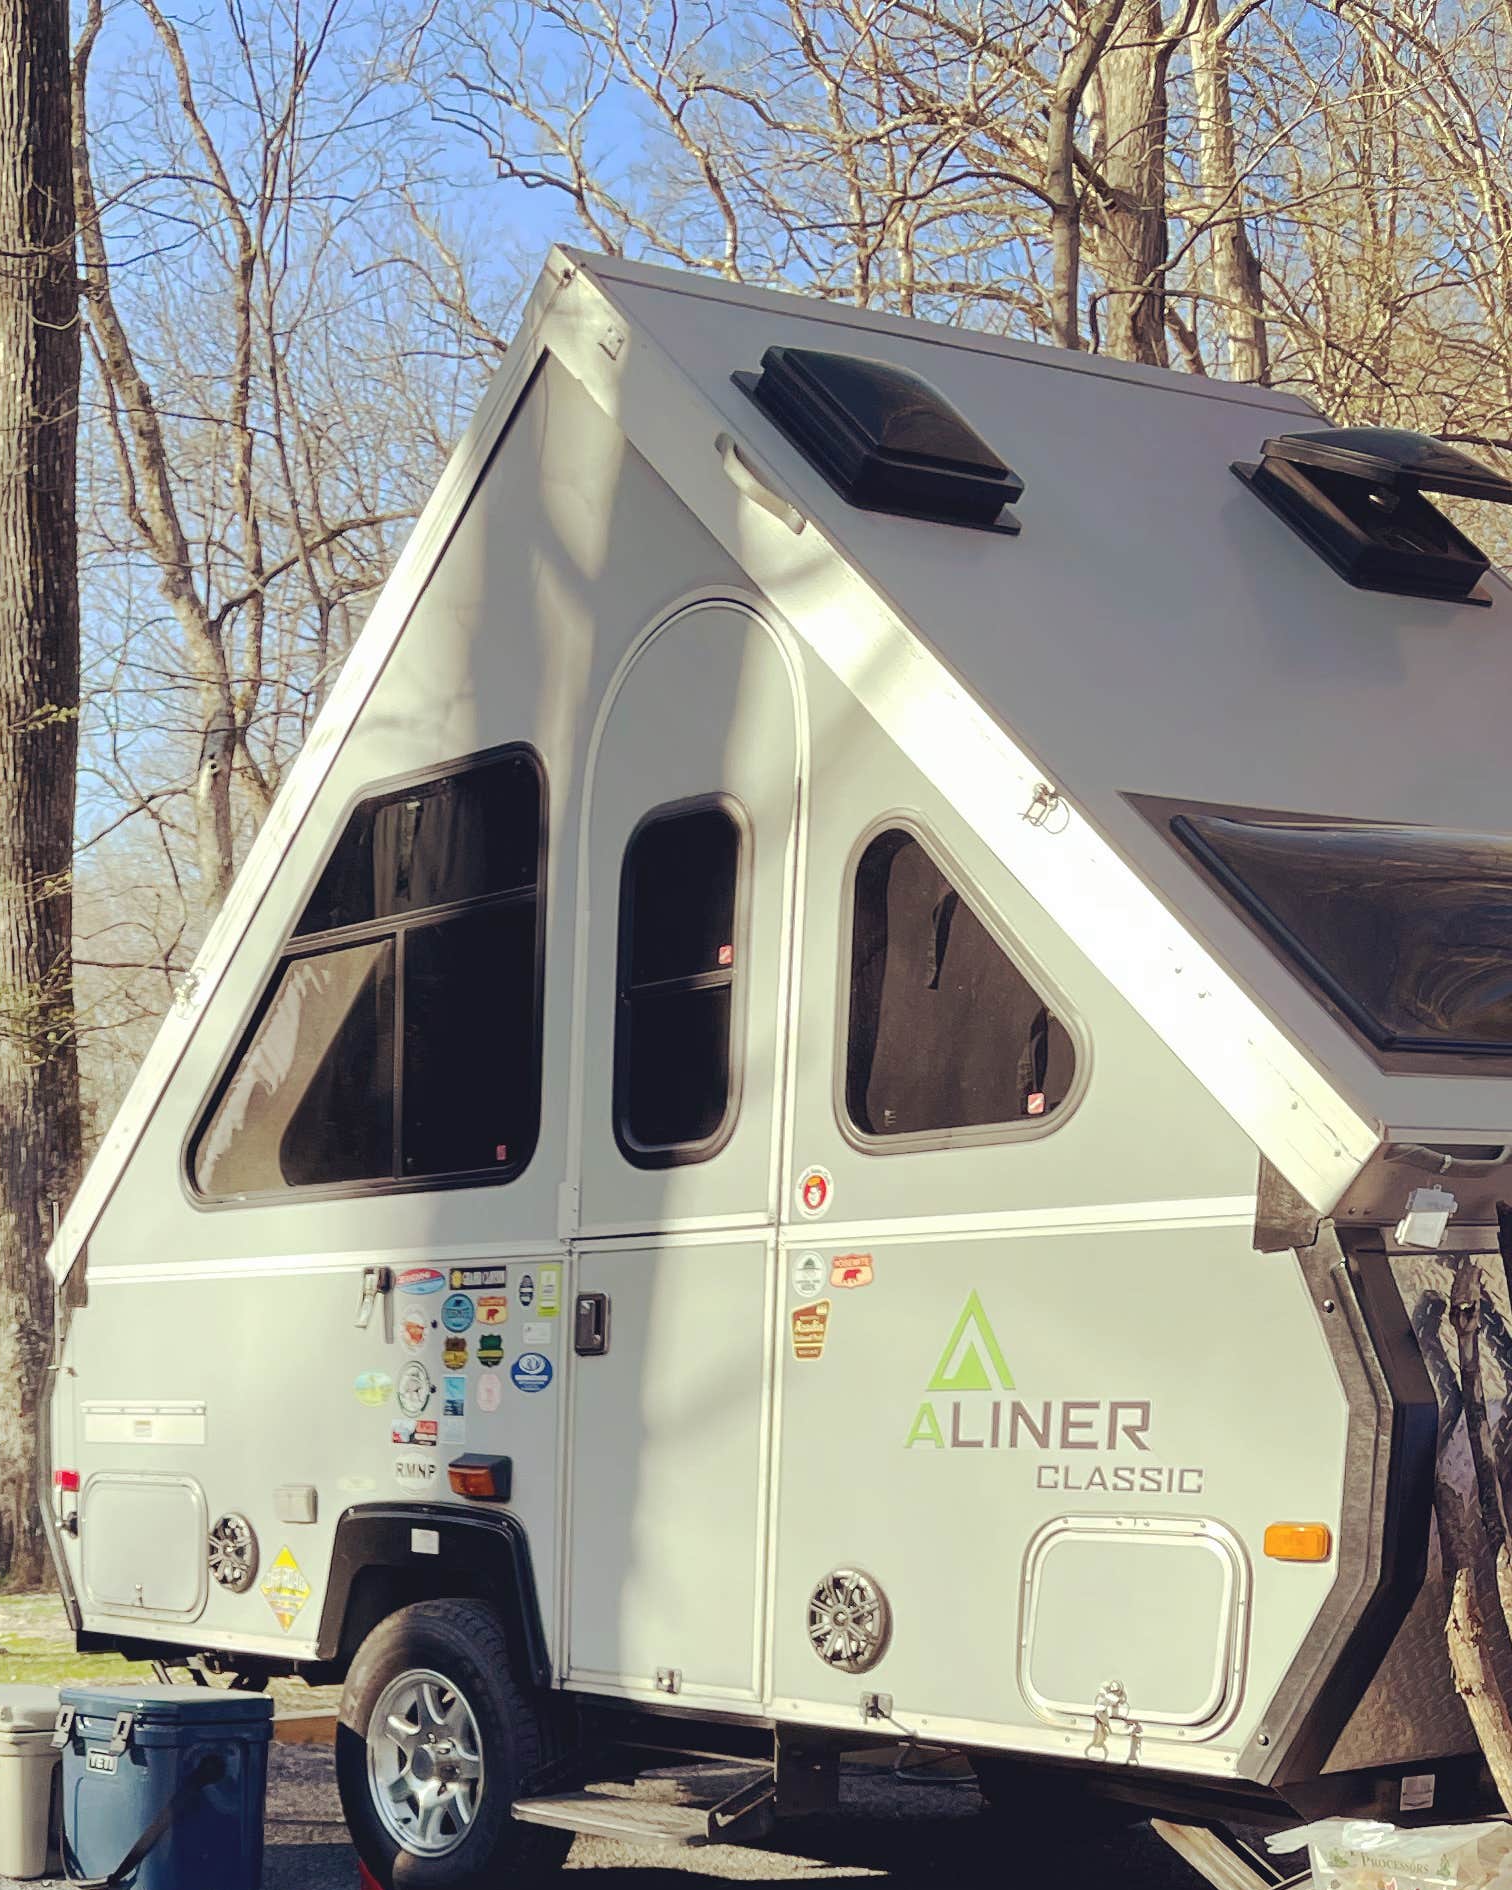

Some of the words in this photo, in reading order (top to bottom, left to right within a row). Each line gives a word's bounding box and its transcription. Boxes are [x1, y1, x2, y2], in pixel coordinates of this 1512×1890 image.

[904, 1400, 1152, 1451] ALINER
[395, 1462, 437, 1480] RMNP
[1036, 1464, 1204, 1494] CLASSIC
[89, 1756, 114, 1771] YETI
